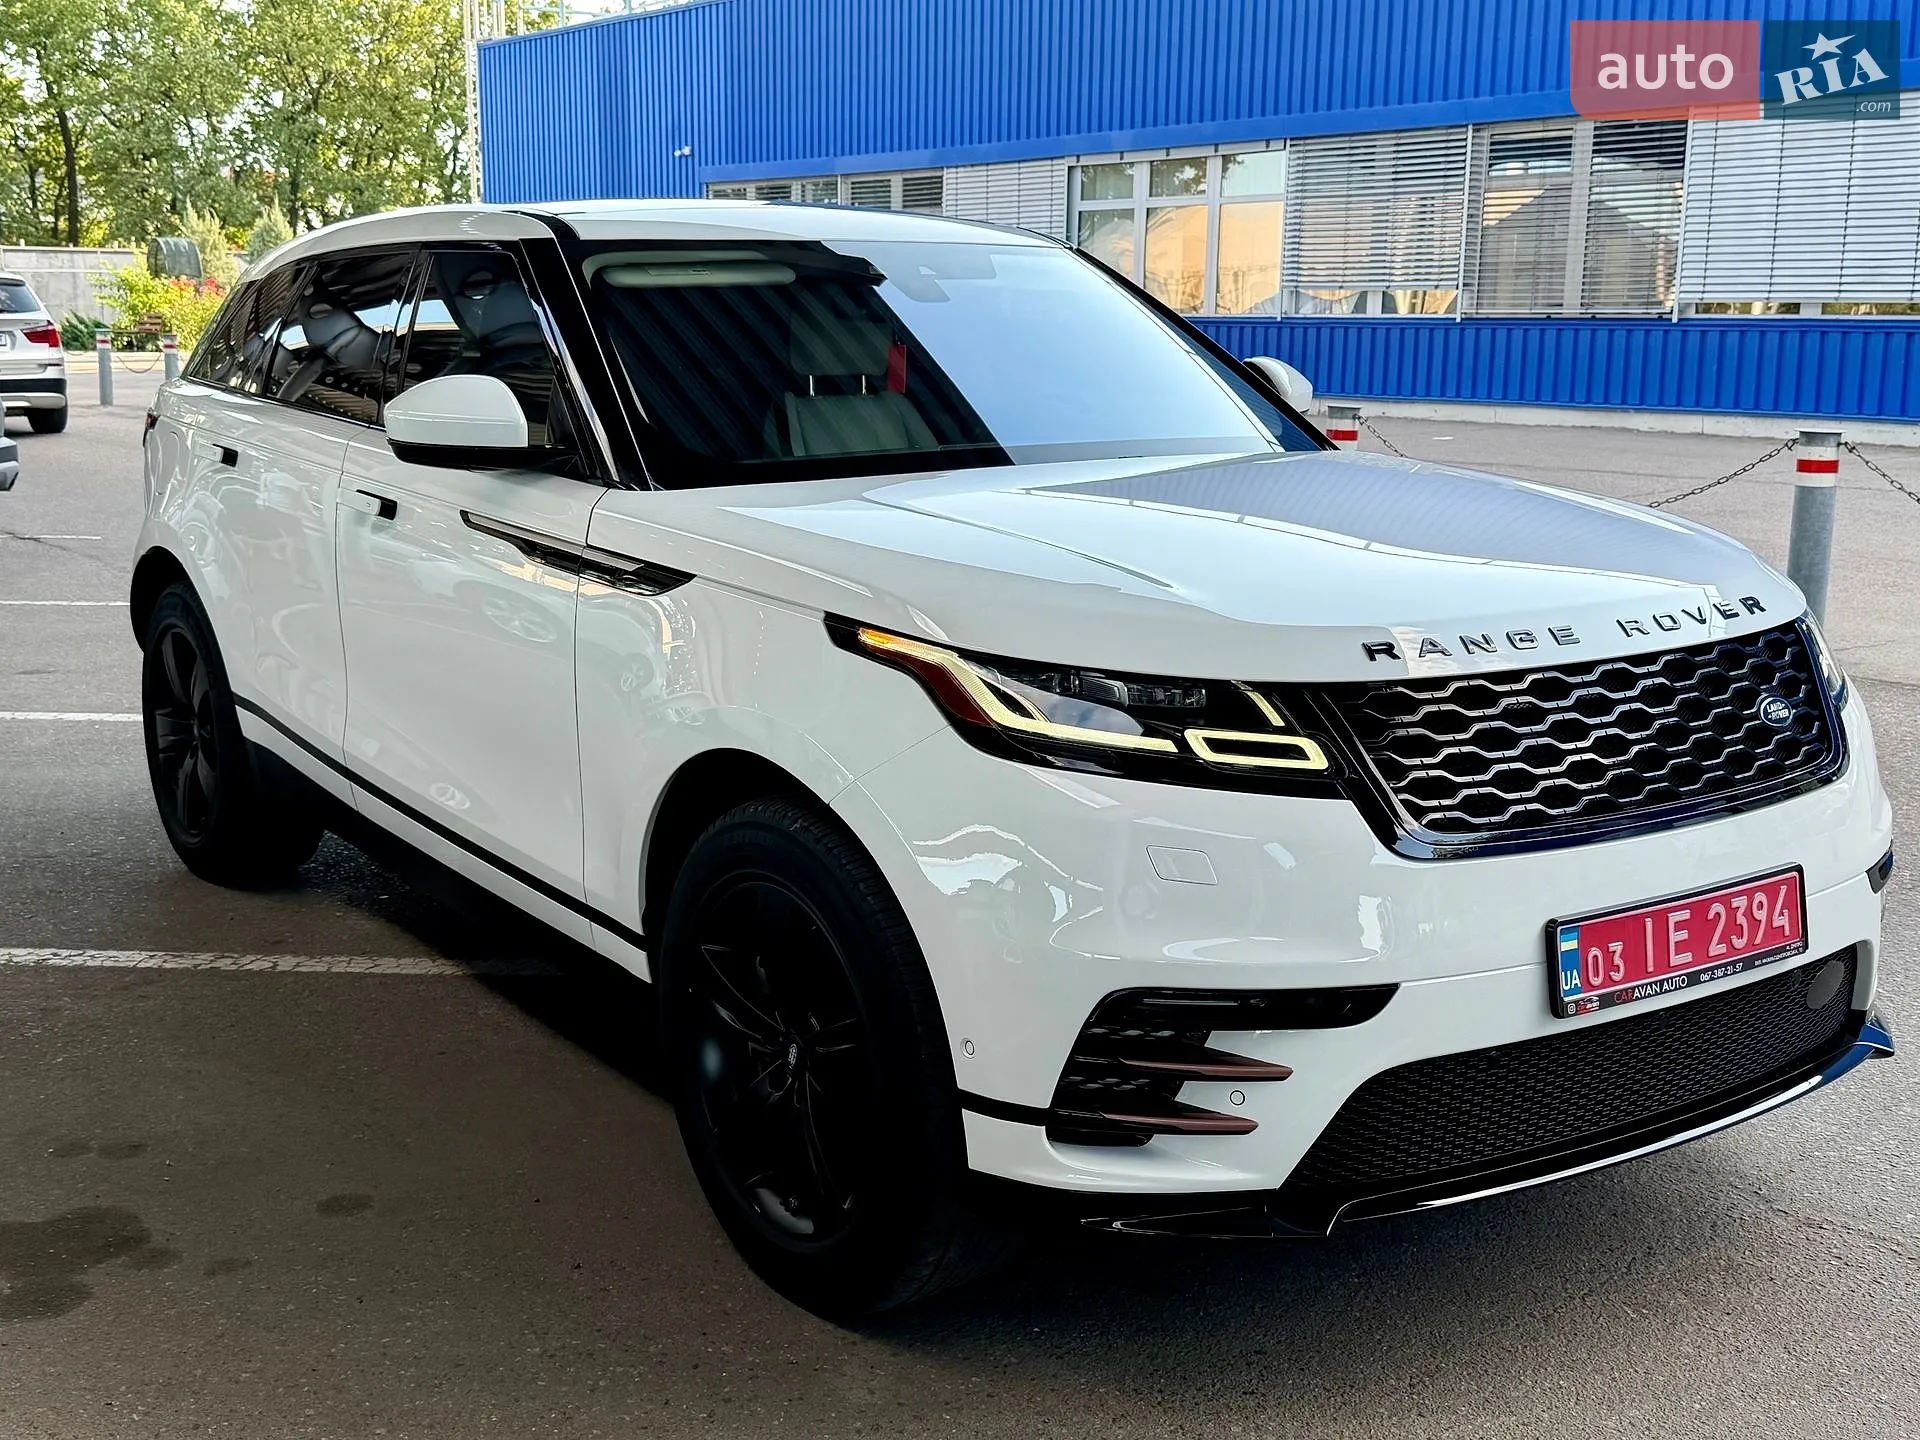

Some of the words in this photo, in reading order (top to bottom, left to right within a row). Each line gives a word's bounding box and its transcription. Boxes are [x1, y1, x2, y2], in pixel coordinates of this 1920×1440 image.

[1361, 623, 1581, 662] RANGE
[1616, 595, 1767, 638] ROVER
[1587, 941, 1625, 987] 03
[1644, 909, 1693, 974] IE
[1707, 885, 1791, 958] 2394
[1562, 968, 1581, 991] UA
[1614, 980, 1661, 1004] CARAVAN
[1662, 975, 1688, 994] AUTO
[1700, 962, 1744, 982] 067-387-21-57
